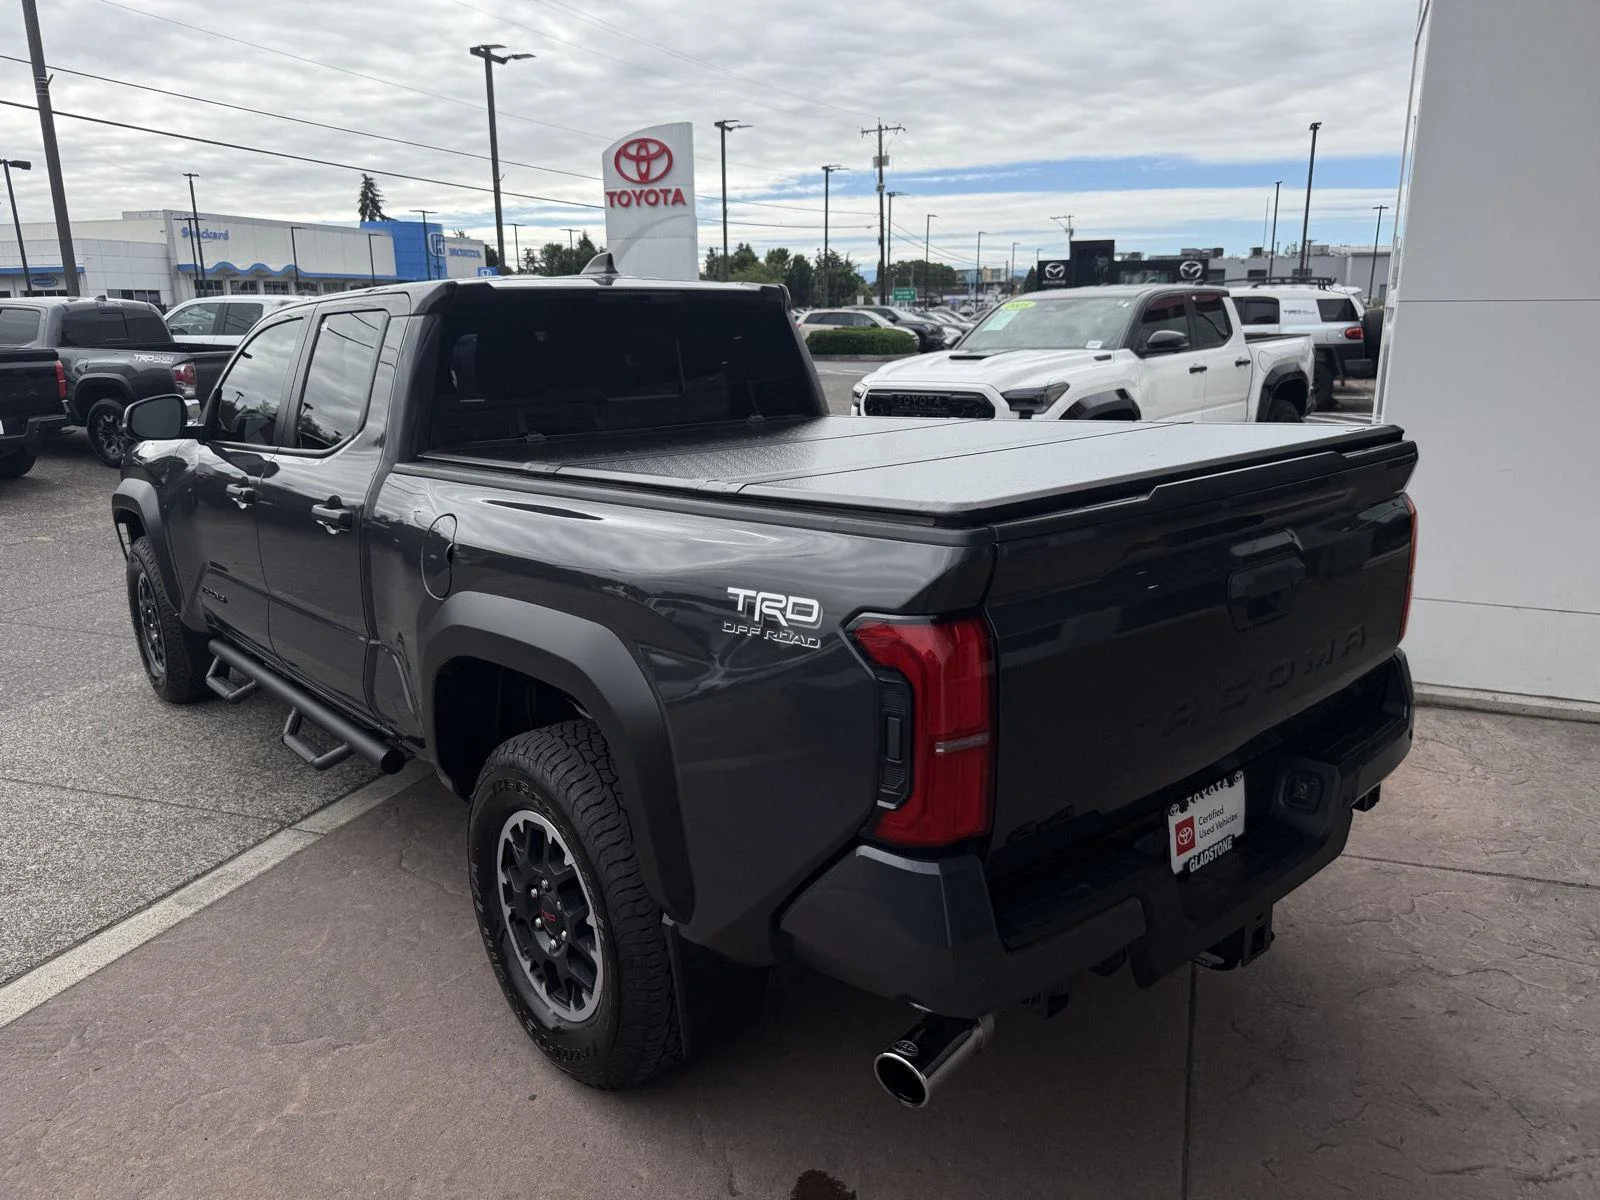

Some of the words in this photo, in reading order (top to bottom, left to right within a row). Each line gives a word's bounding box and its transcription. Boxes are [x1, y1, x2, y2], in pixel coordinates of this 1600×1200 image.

[605, 188, 687, 208] TOYOTA
[134, 354, 154, 362] TRD
[896, 395, 942, 409] TOYOTA
[726, 586, 823, 630] TRD
[722, 621, 762, 637] OFF
[763, 630, 821, 650] ROAD
[1186, 778, 1229, 806] TOYOTA
[1197, 805, 1224, 826] Certified
[1198, 823, 1215, 839] Used
[1215, 812, 1238, 831] Vehicles
[1189, 836, 1234, 873] GLADSTONE
